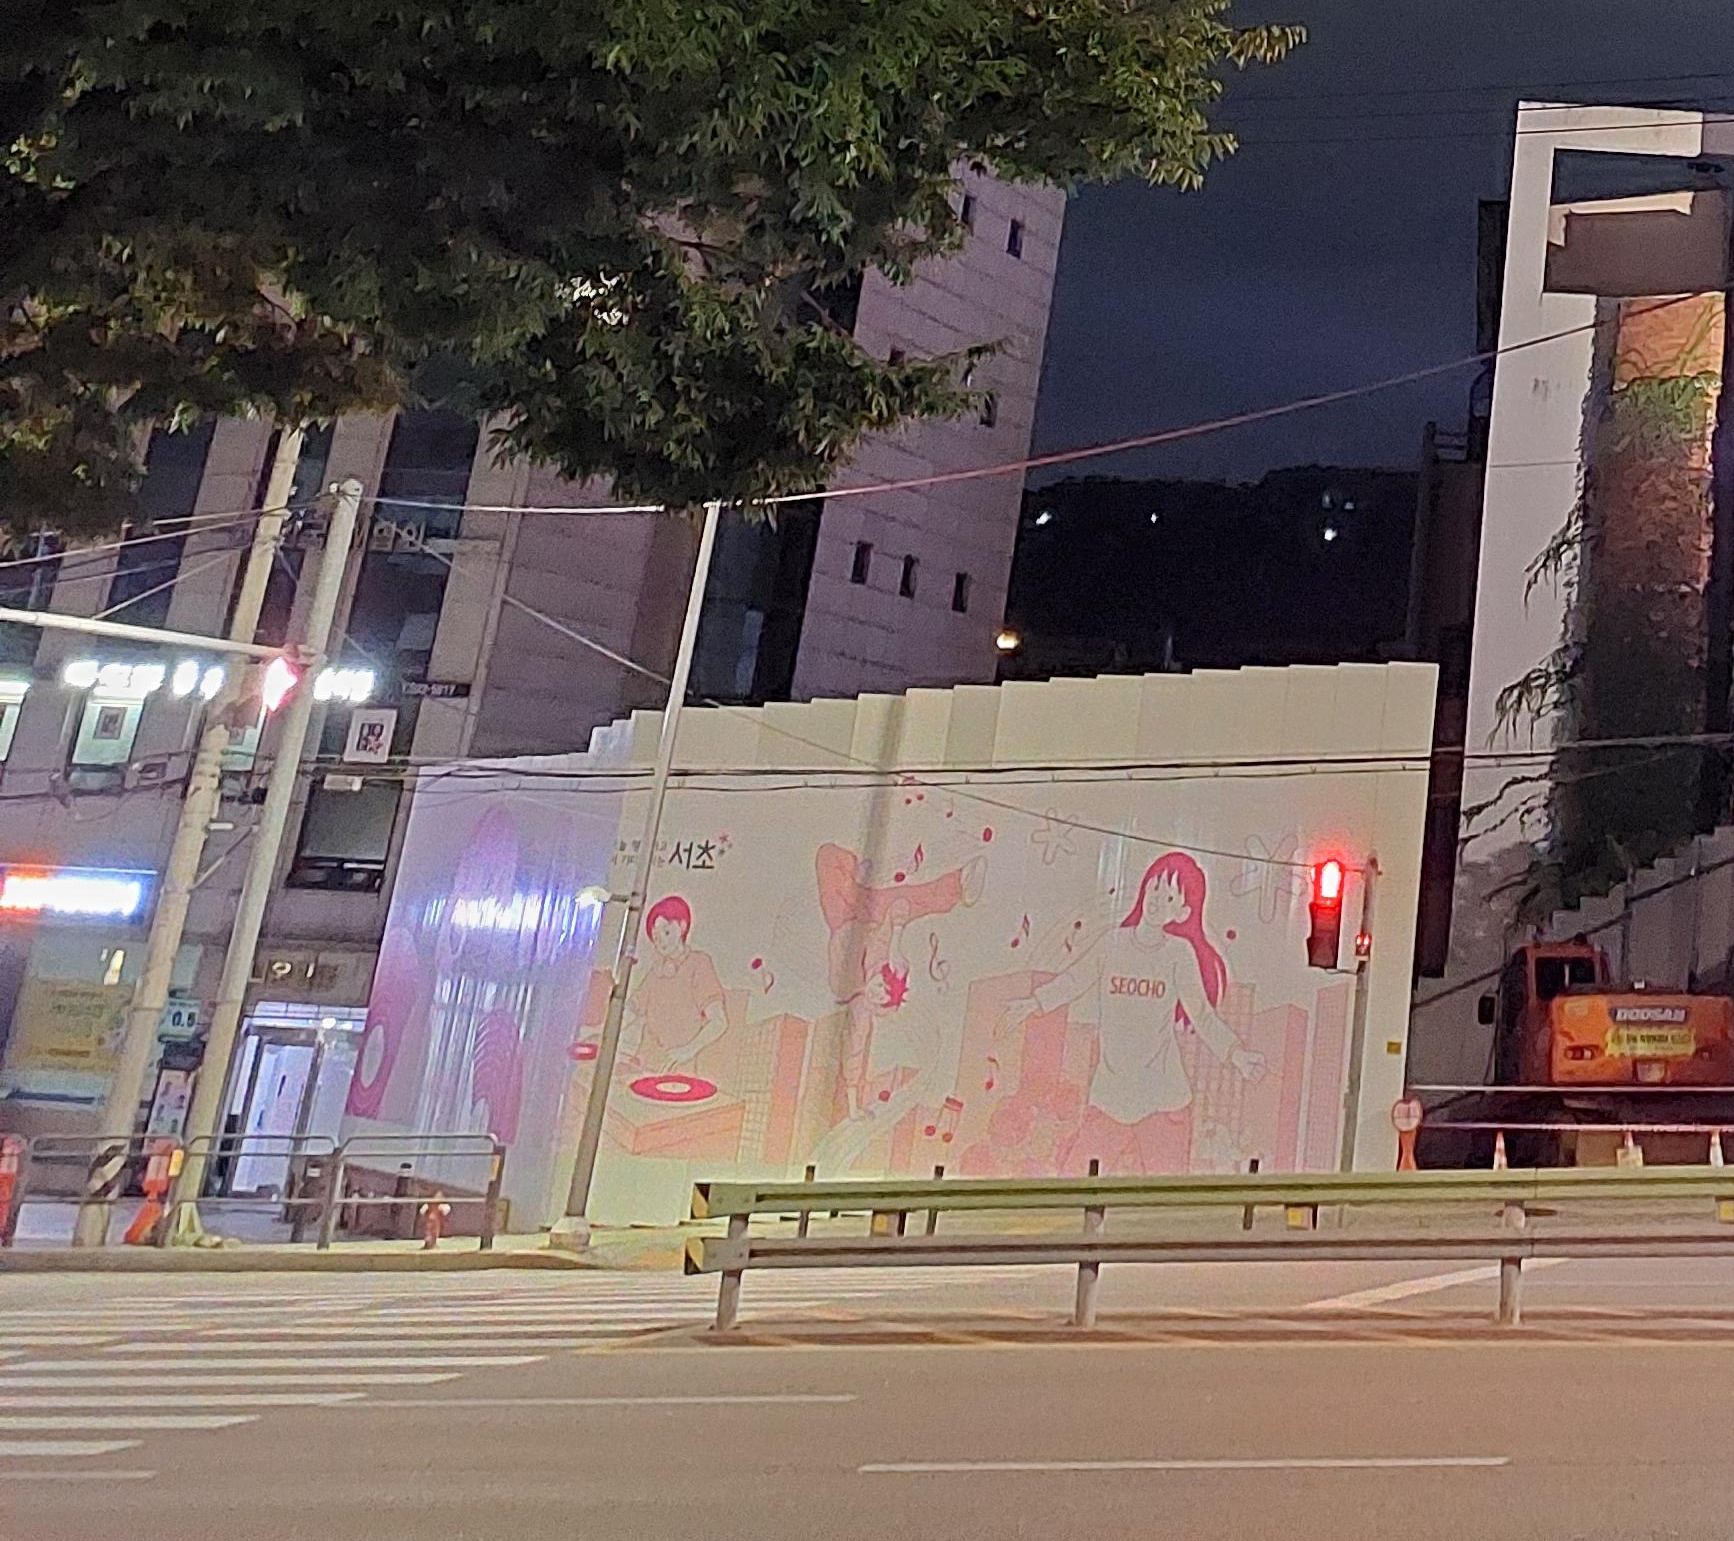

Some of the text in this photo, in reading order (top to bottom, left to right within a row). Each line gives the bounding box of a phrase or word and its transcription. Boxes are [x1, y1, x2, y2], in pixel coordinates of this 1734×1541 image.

[668, 839, 716, 870] 서초
[1109, 975, 1166, 998] SEOCHO
[1616, 1007, 1686, 1022] DOOSAN
